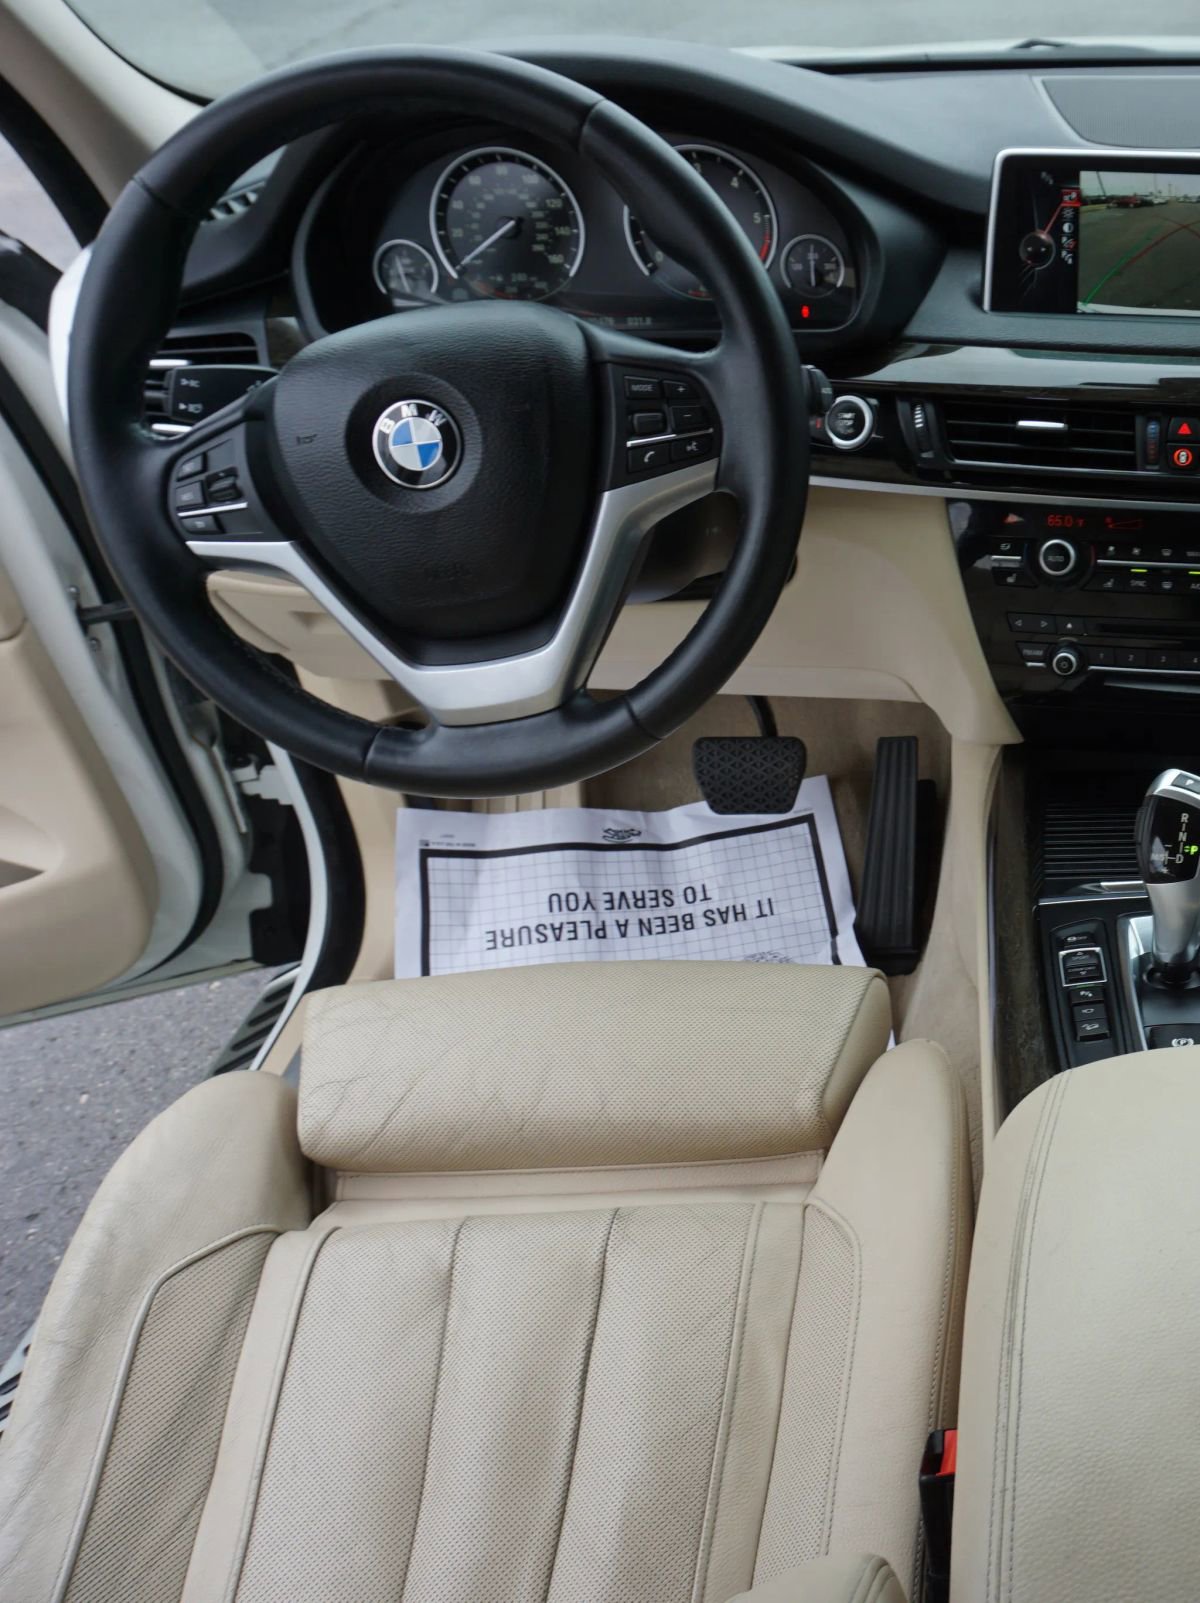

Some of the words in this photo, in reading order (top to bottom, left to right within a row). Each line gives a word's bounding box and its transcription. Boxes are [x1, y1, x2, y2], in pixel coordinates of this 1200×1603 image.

[730, 177, 739, 188] 4
[753, 212, 761, 224] 5
[379, 403, 448, 434] BMW
[1181, 813, 1189, 823] R
[1178, 832, 1187, 842] N
[1175, 854, 1184, 864] D
[1190, 845, 1199, 855] P
[548, 891, 596, 913] YOU
[602, 888, 675, 911] SERVE
[683, 883, 712, 905] TO
[703, 903, 747, 927] HAS
[755, 897, 775, 919] IT
[485, 920, 607, 951] PLEASURE
[615, 918, 629, 938] A
[638, 913, 695, 936] BEEN
